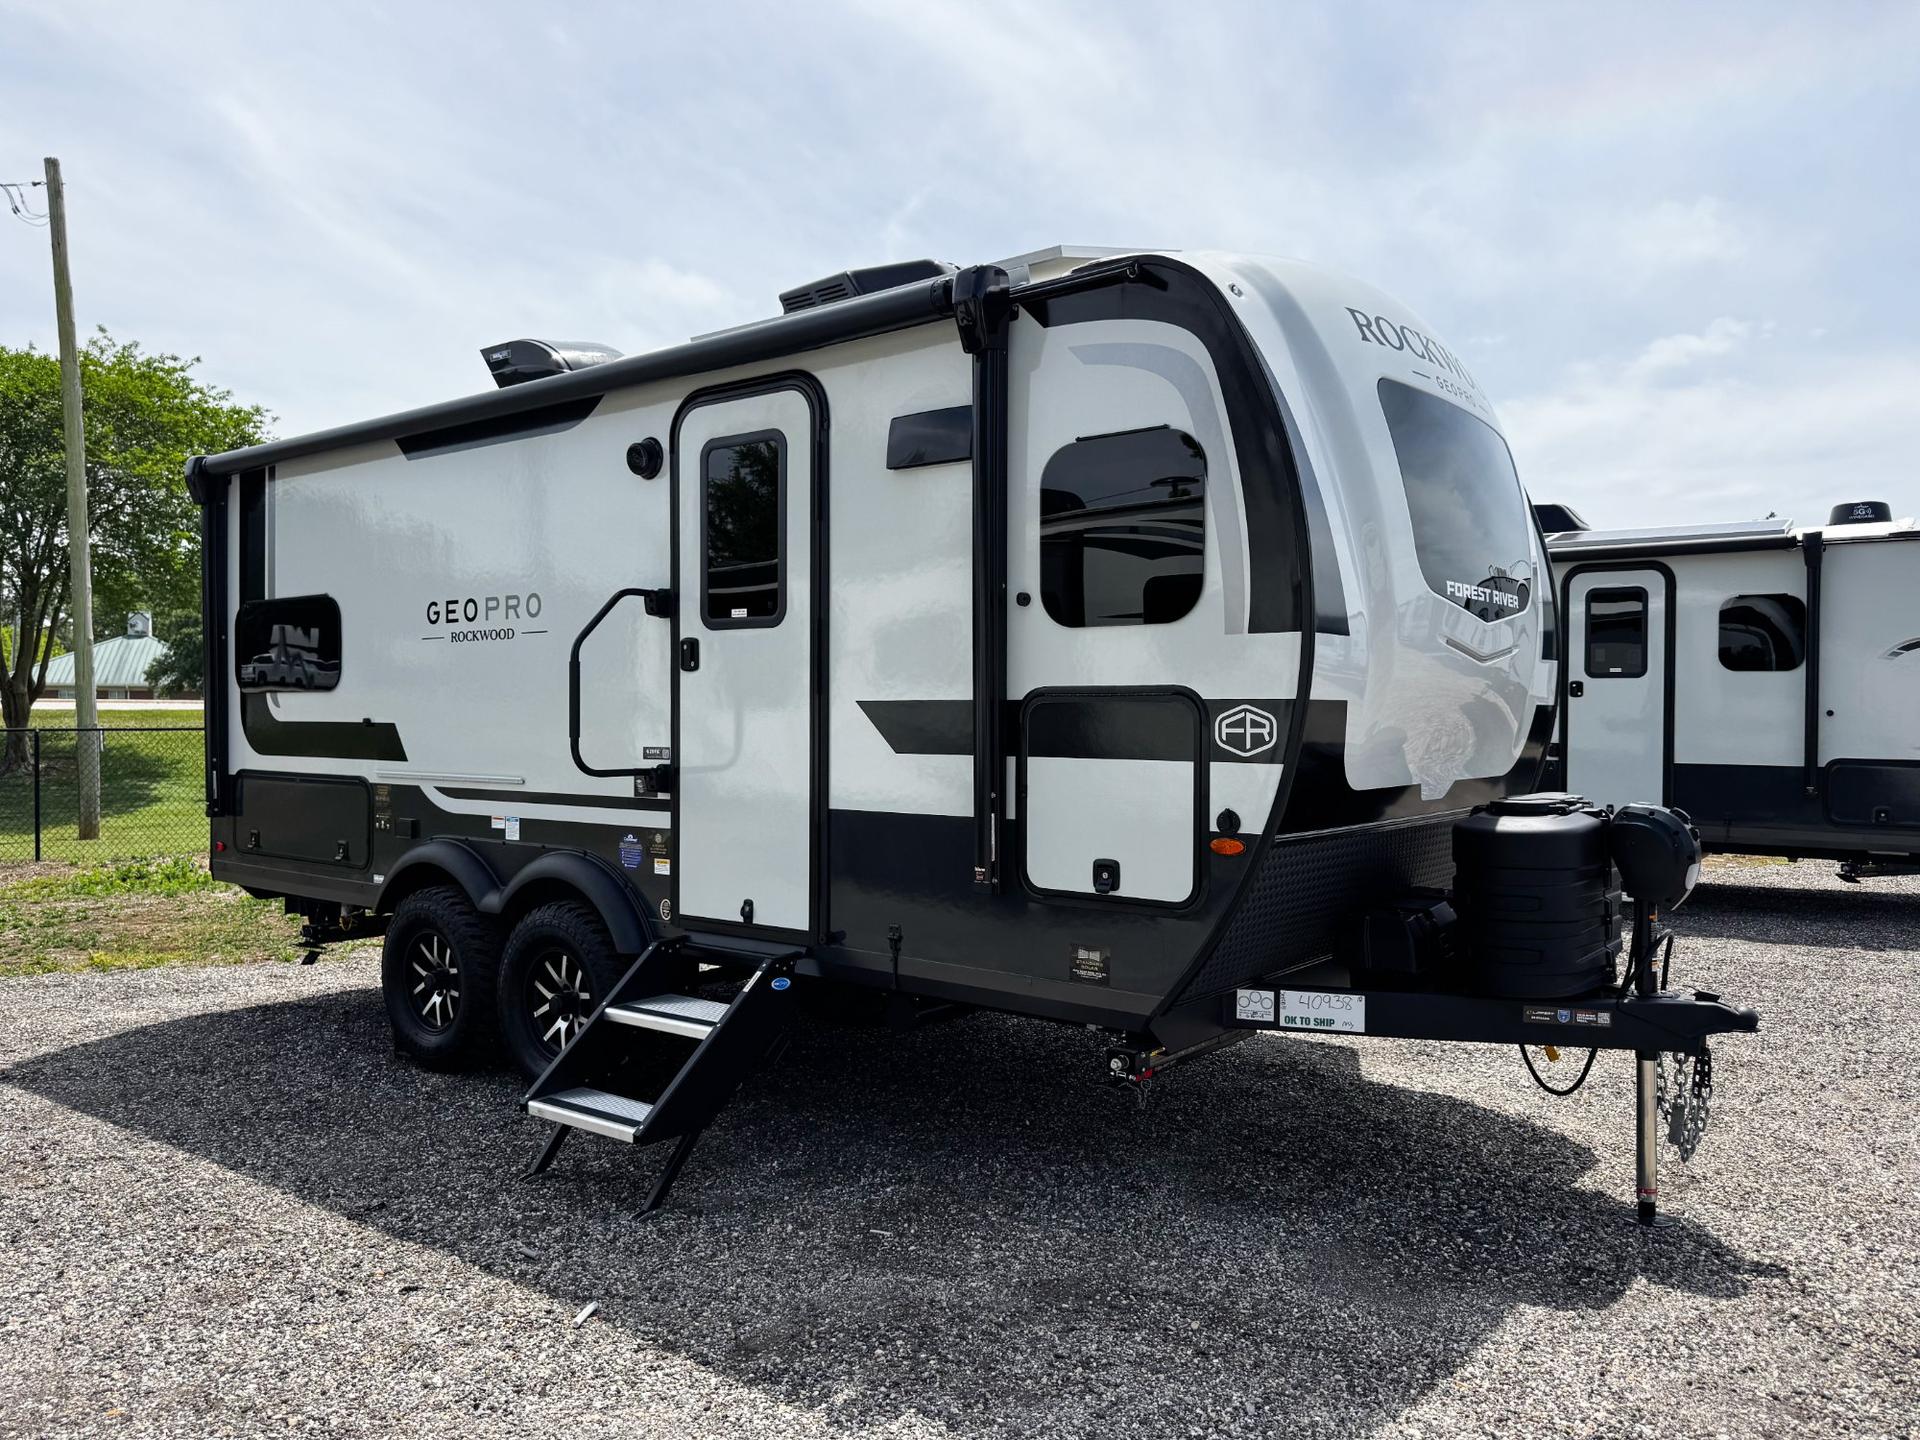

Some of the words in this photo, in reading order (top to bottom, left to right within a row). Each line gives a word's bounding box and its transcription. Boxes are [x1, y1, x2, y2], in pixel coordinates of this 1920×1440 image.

[1344, 306, 1482, 395] ROCKWO
[1446, 580, 1492, 602] FOREST
[1492, 589, 1519, 609] RIVER
[450, 628, 515, 643] ROCKWOOD
[1299, 994, 1353, 1011] 40938
[1284, 1015, 1297, 1025] OK
[1299, 1016, 1311, 1026] TO
[1313, 1018, 1335, 1027] SHIP
